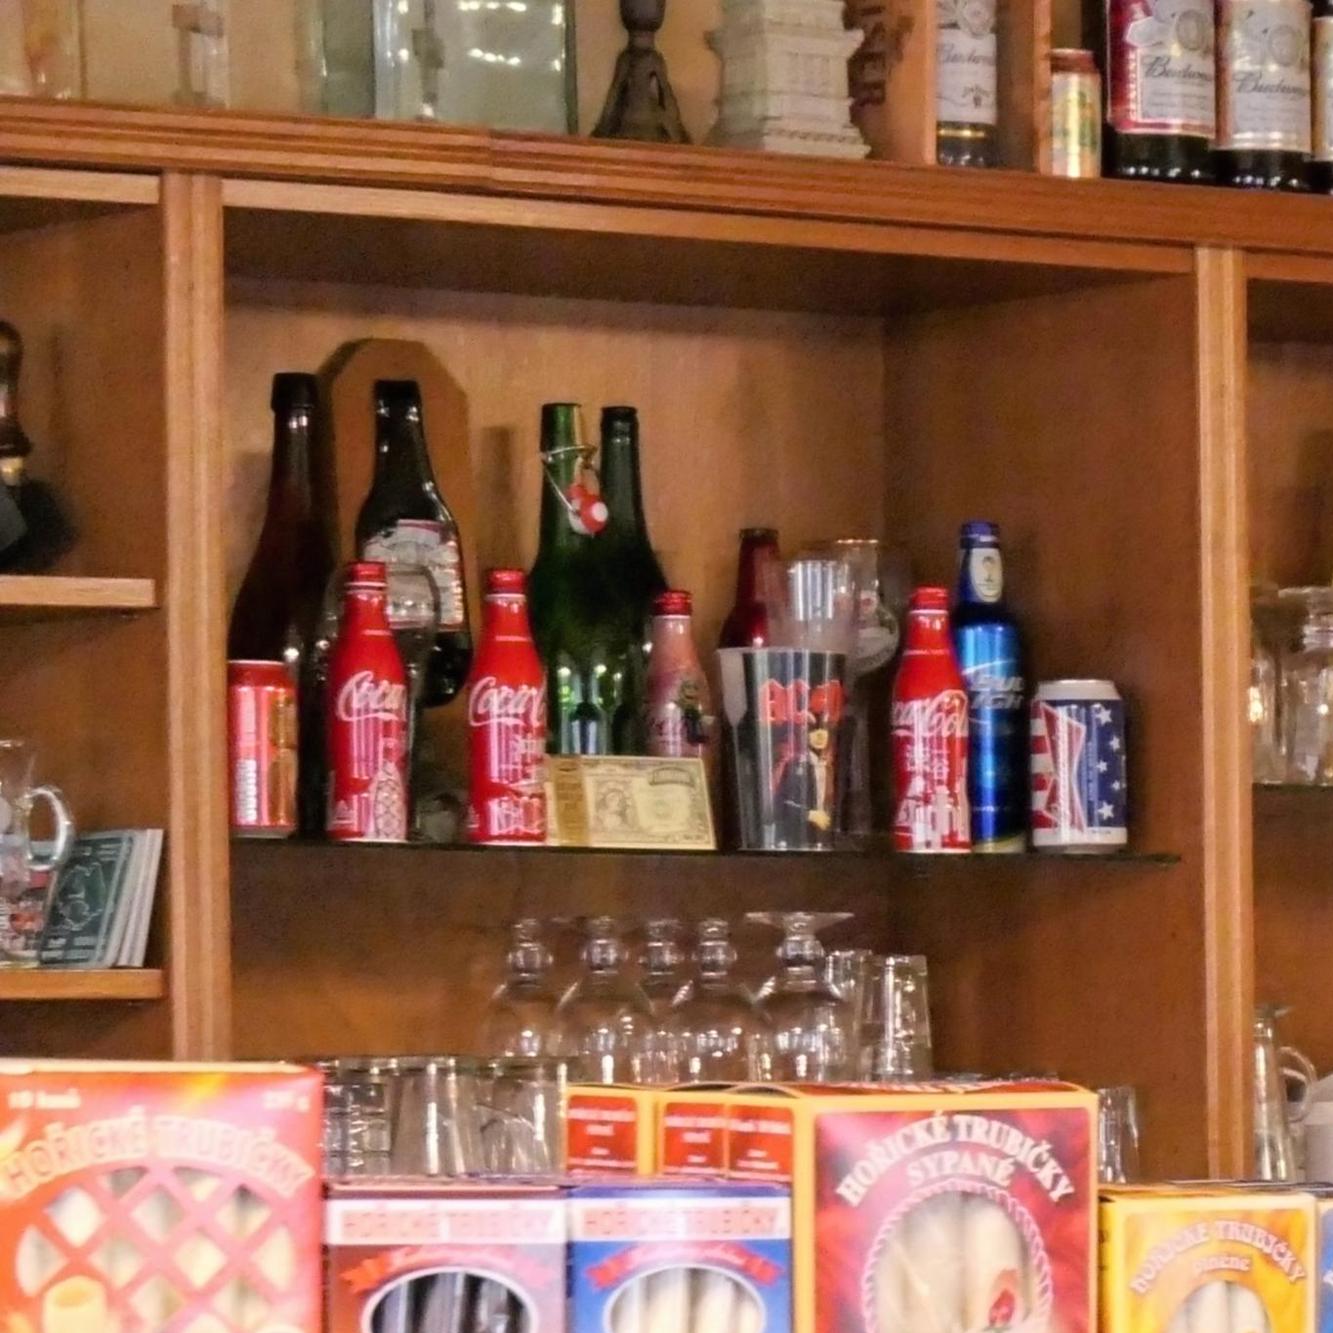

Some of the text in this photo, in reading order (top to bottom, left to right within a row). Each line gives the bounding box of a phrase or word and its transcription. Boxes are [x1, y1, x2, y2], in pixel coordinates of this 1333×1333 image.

[836, 1108, 953, 1208] HOŘICKÉ
[954, 1113, 1075, 1203] TRUBIČKY
[905, 1149, 1015, 1191] SYPANÉ
